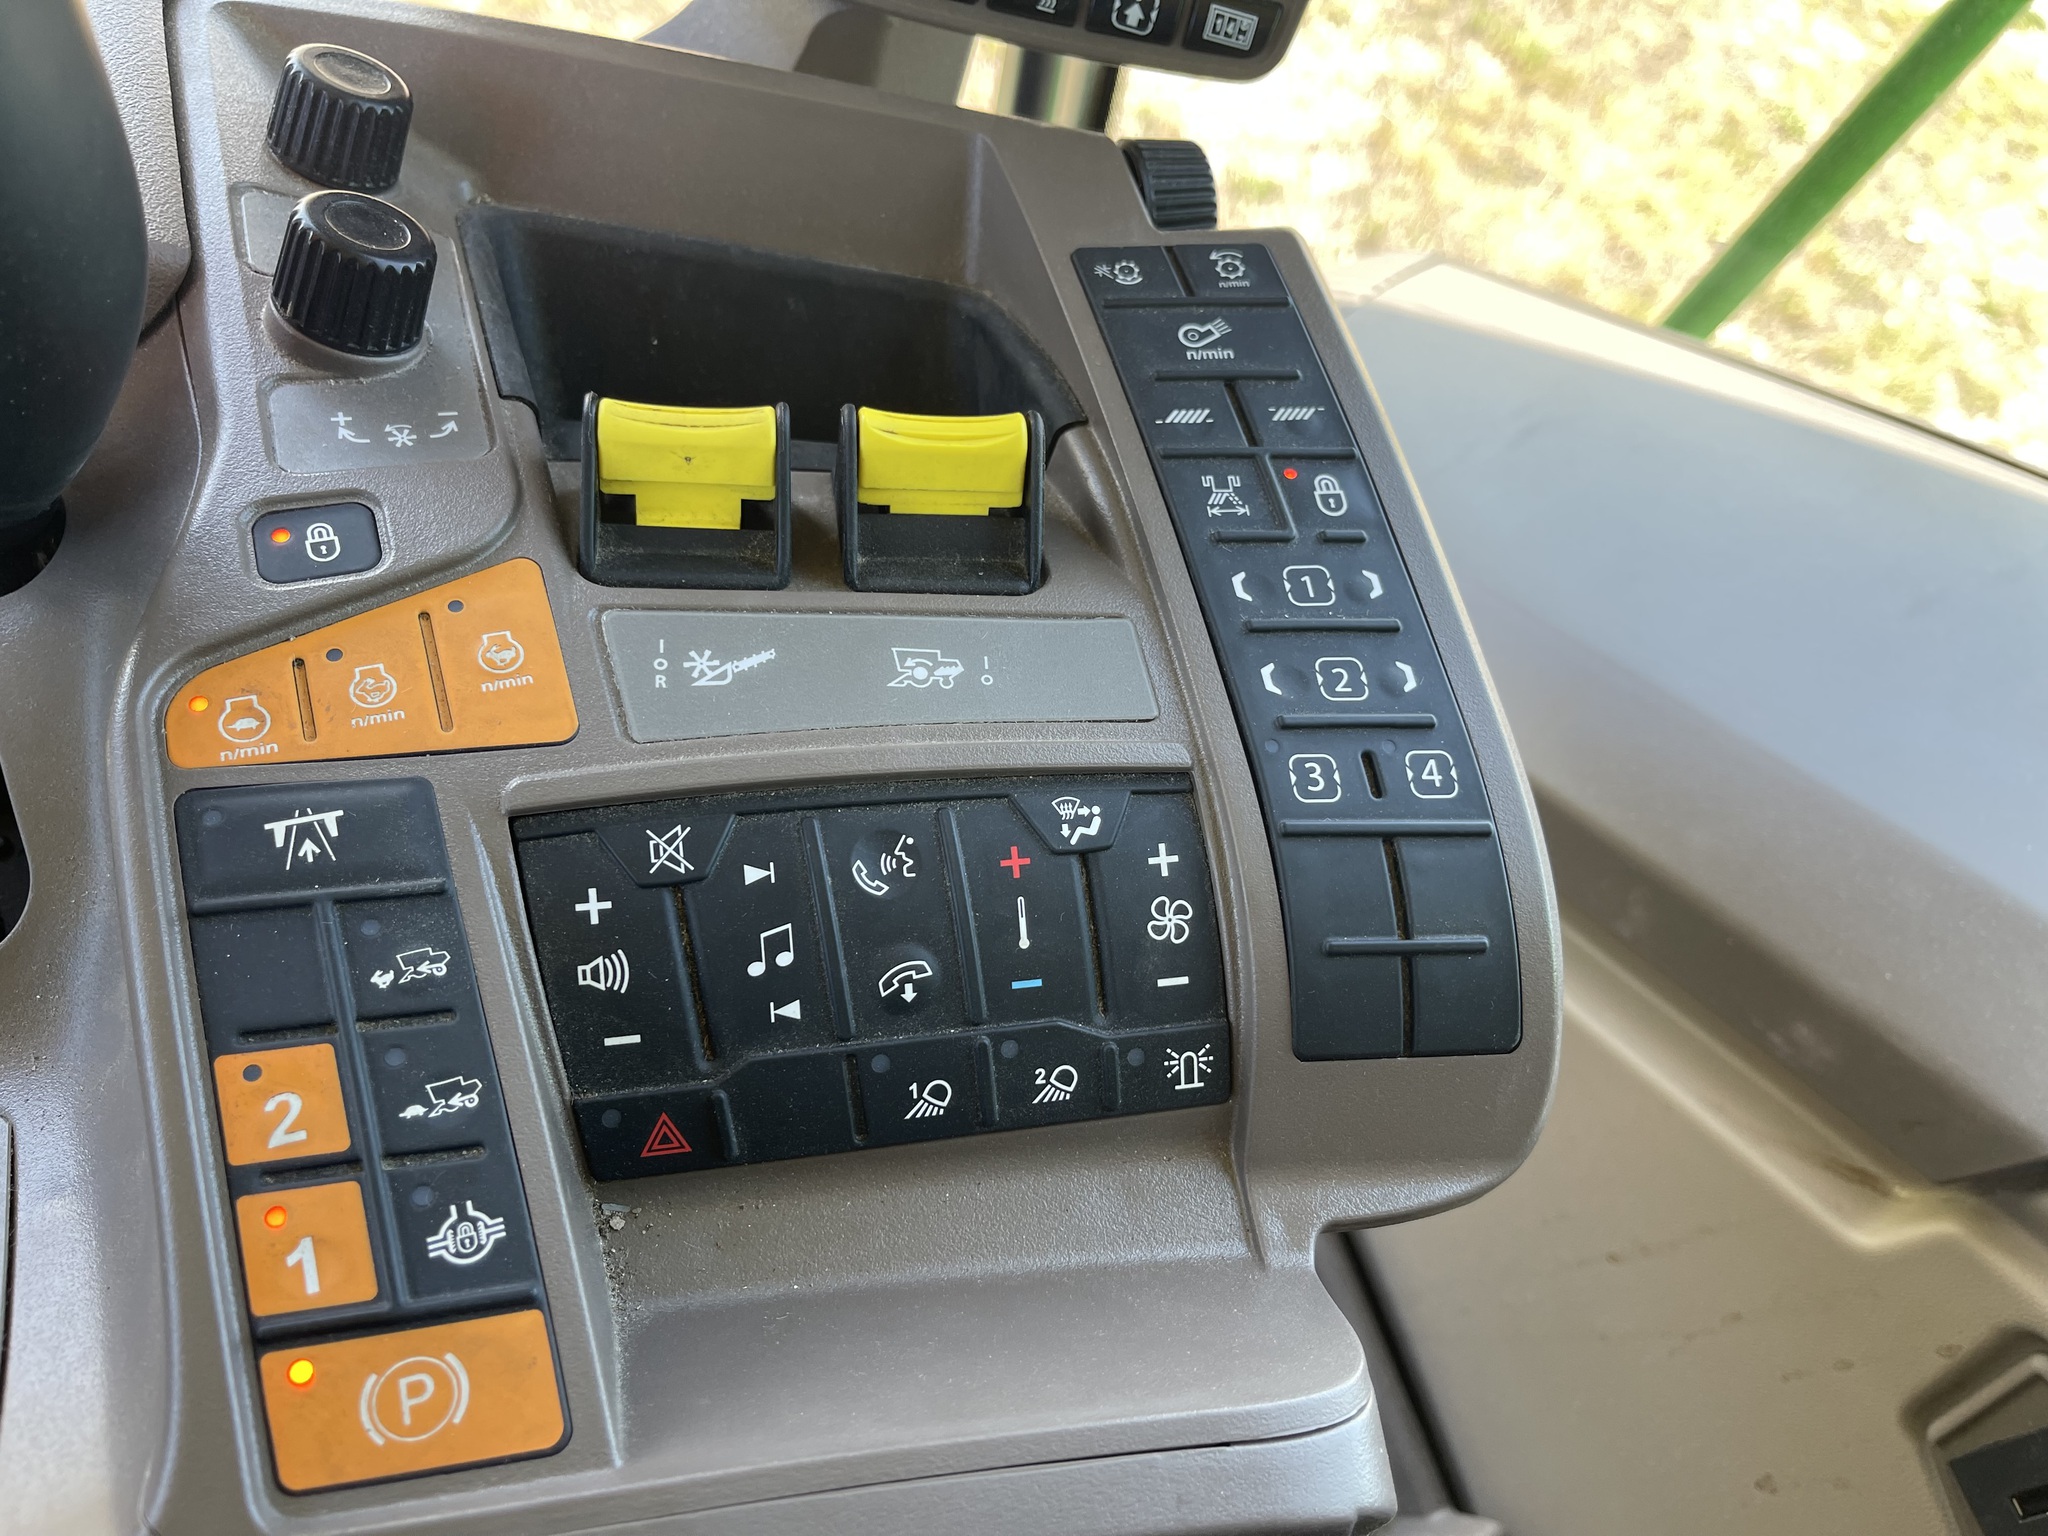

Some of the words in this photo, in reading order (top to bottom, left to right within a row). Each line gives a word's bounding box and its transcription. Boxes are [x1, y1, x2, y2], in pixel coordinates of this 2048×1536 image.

[1219, 278, 1250, 288] n/min
[1186, 346, 1235, 360] n/min
[1300, 575, 1315, 598] 1
[481, 673, 534, 692] n/min
[655, 675, 668, 688] R
[1331, 668, 1352, 692] 2
[350, 708, 405, 728] n/min
[219, 740, 279, 762] n/min
[1304, 762, 1325, 791] 3
[1421, 759, 1443, 787] 4
[1034, 1068, 1046, 1085] 2
[909, 1082, 918, 1099] 1
[264, 1091, 307, 1149] 2
[286, 1236, 320, 1295] 1
[398, 1372, 434, 1426] P
